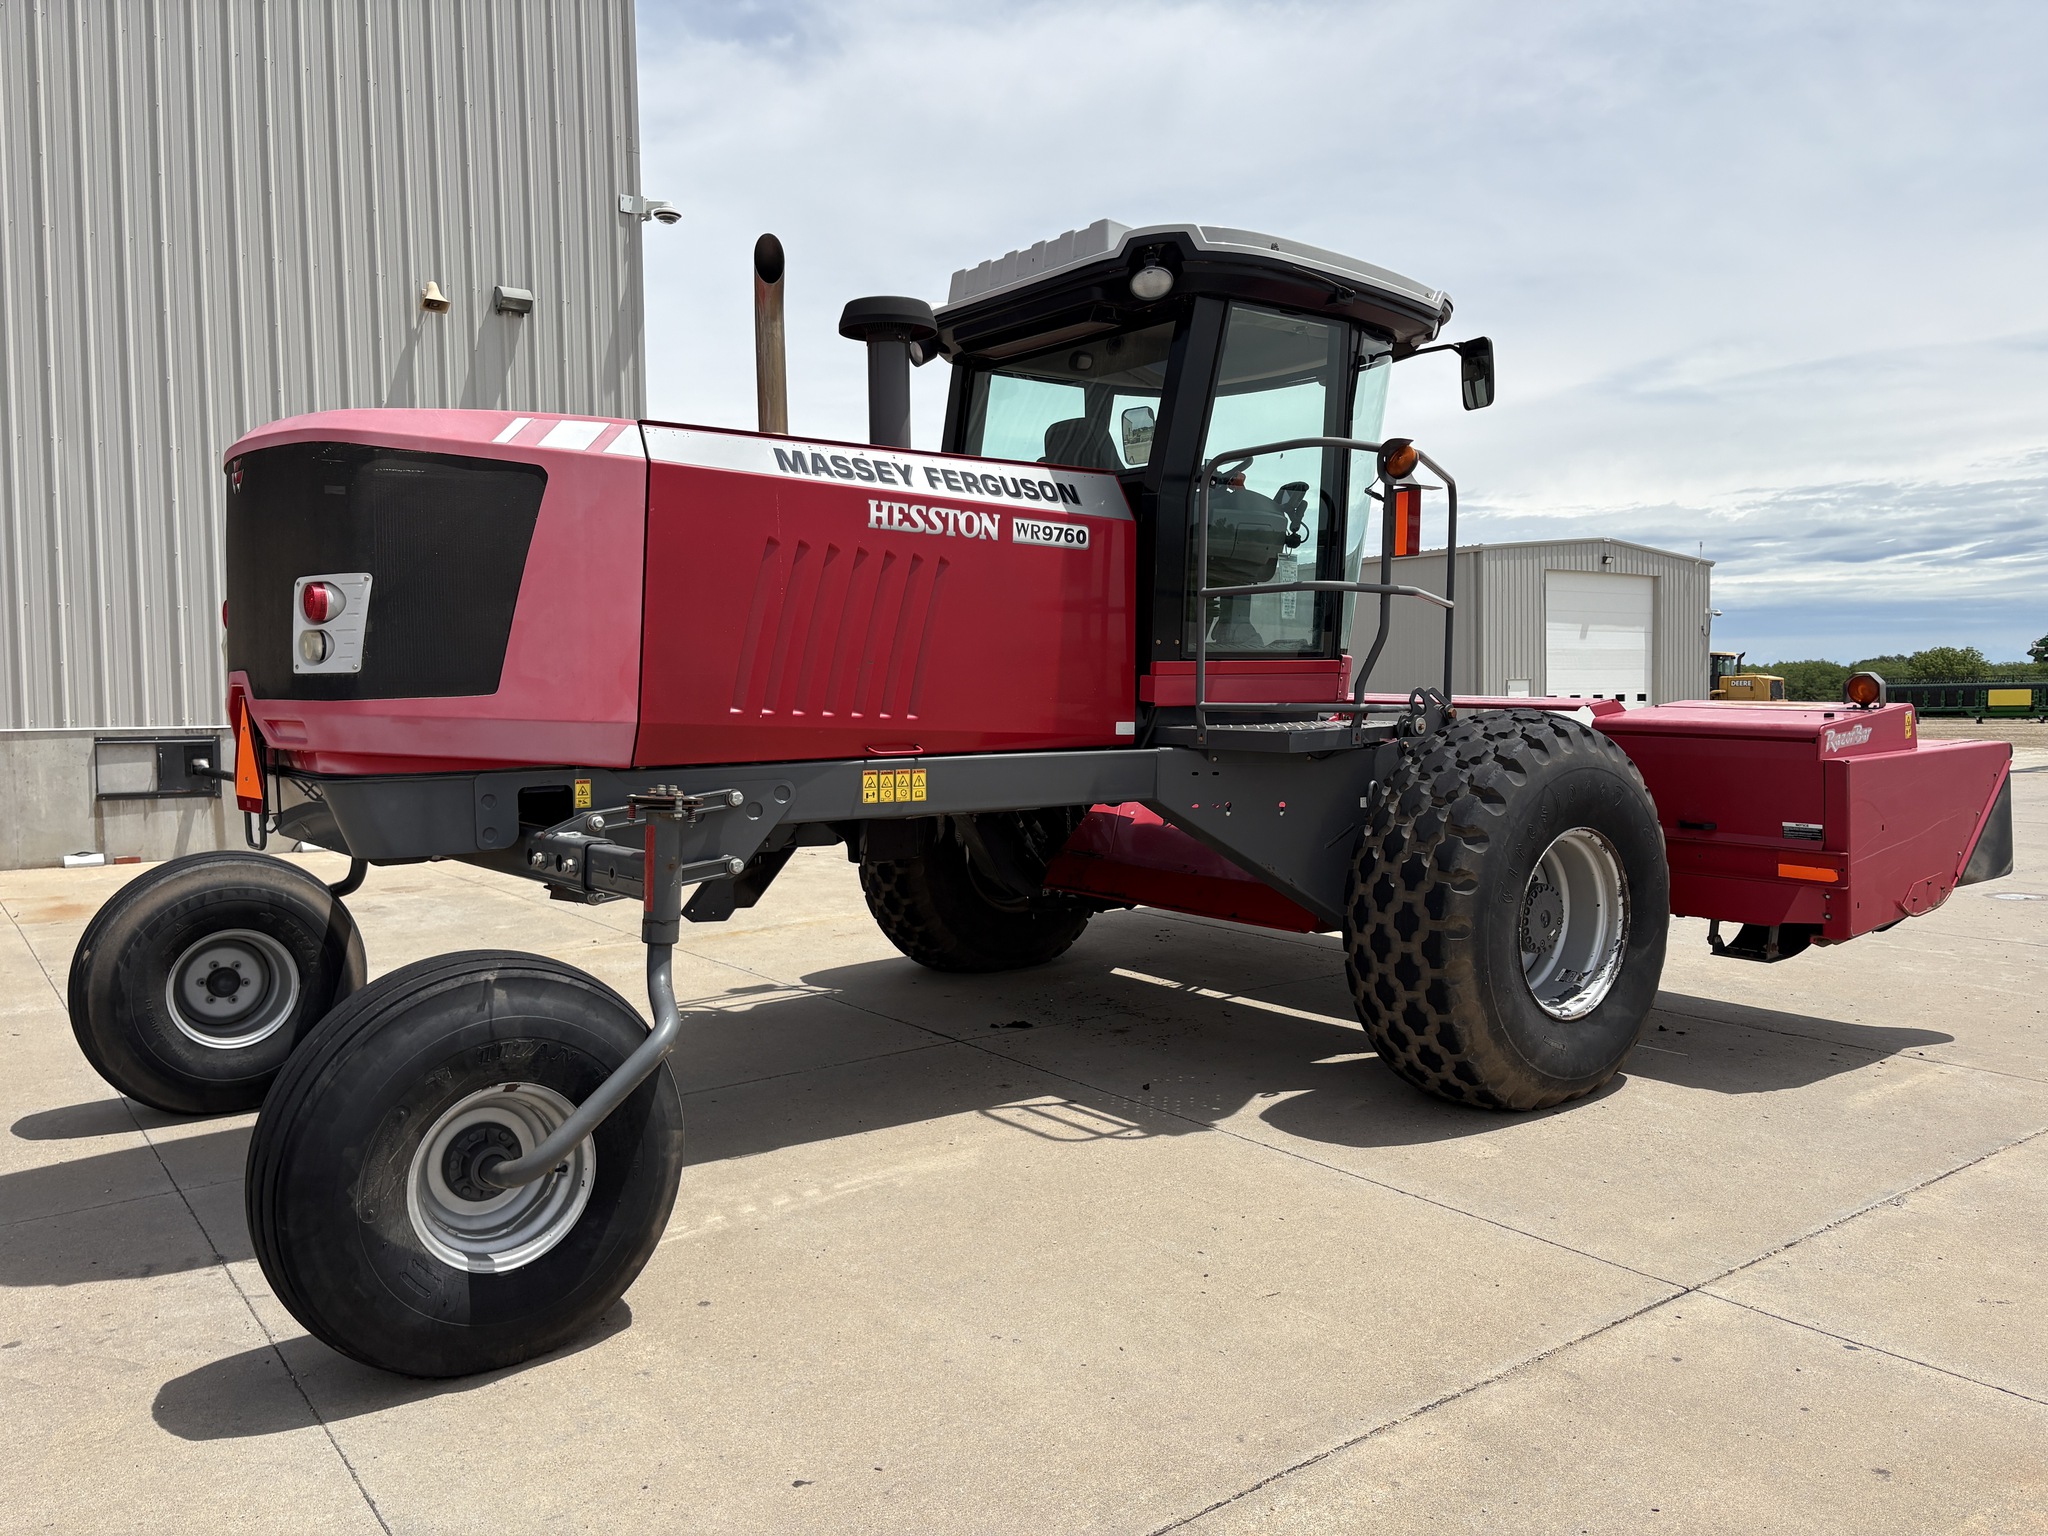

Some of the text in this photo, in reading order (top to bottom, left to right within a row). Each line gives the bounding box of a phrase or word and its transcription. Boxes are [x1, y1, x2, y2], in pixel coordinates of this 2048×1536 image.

[773, 447, 1082, 505] MASSEY FERGUSON
[867, 498, 1000, 541] HESSTON
[1015, 521, 1087, 545] WR9760
[477, 1038, 582, 1066] TITAN
